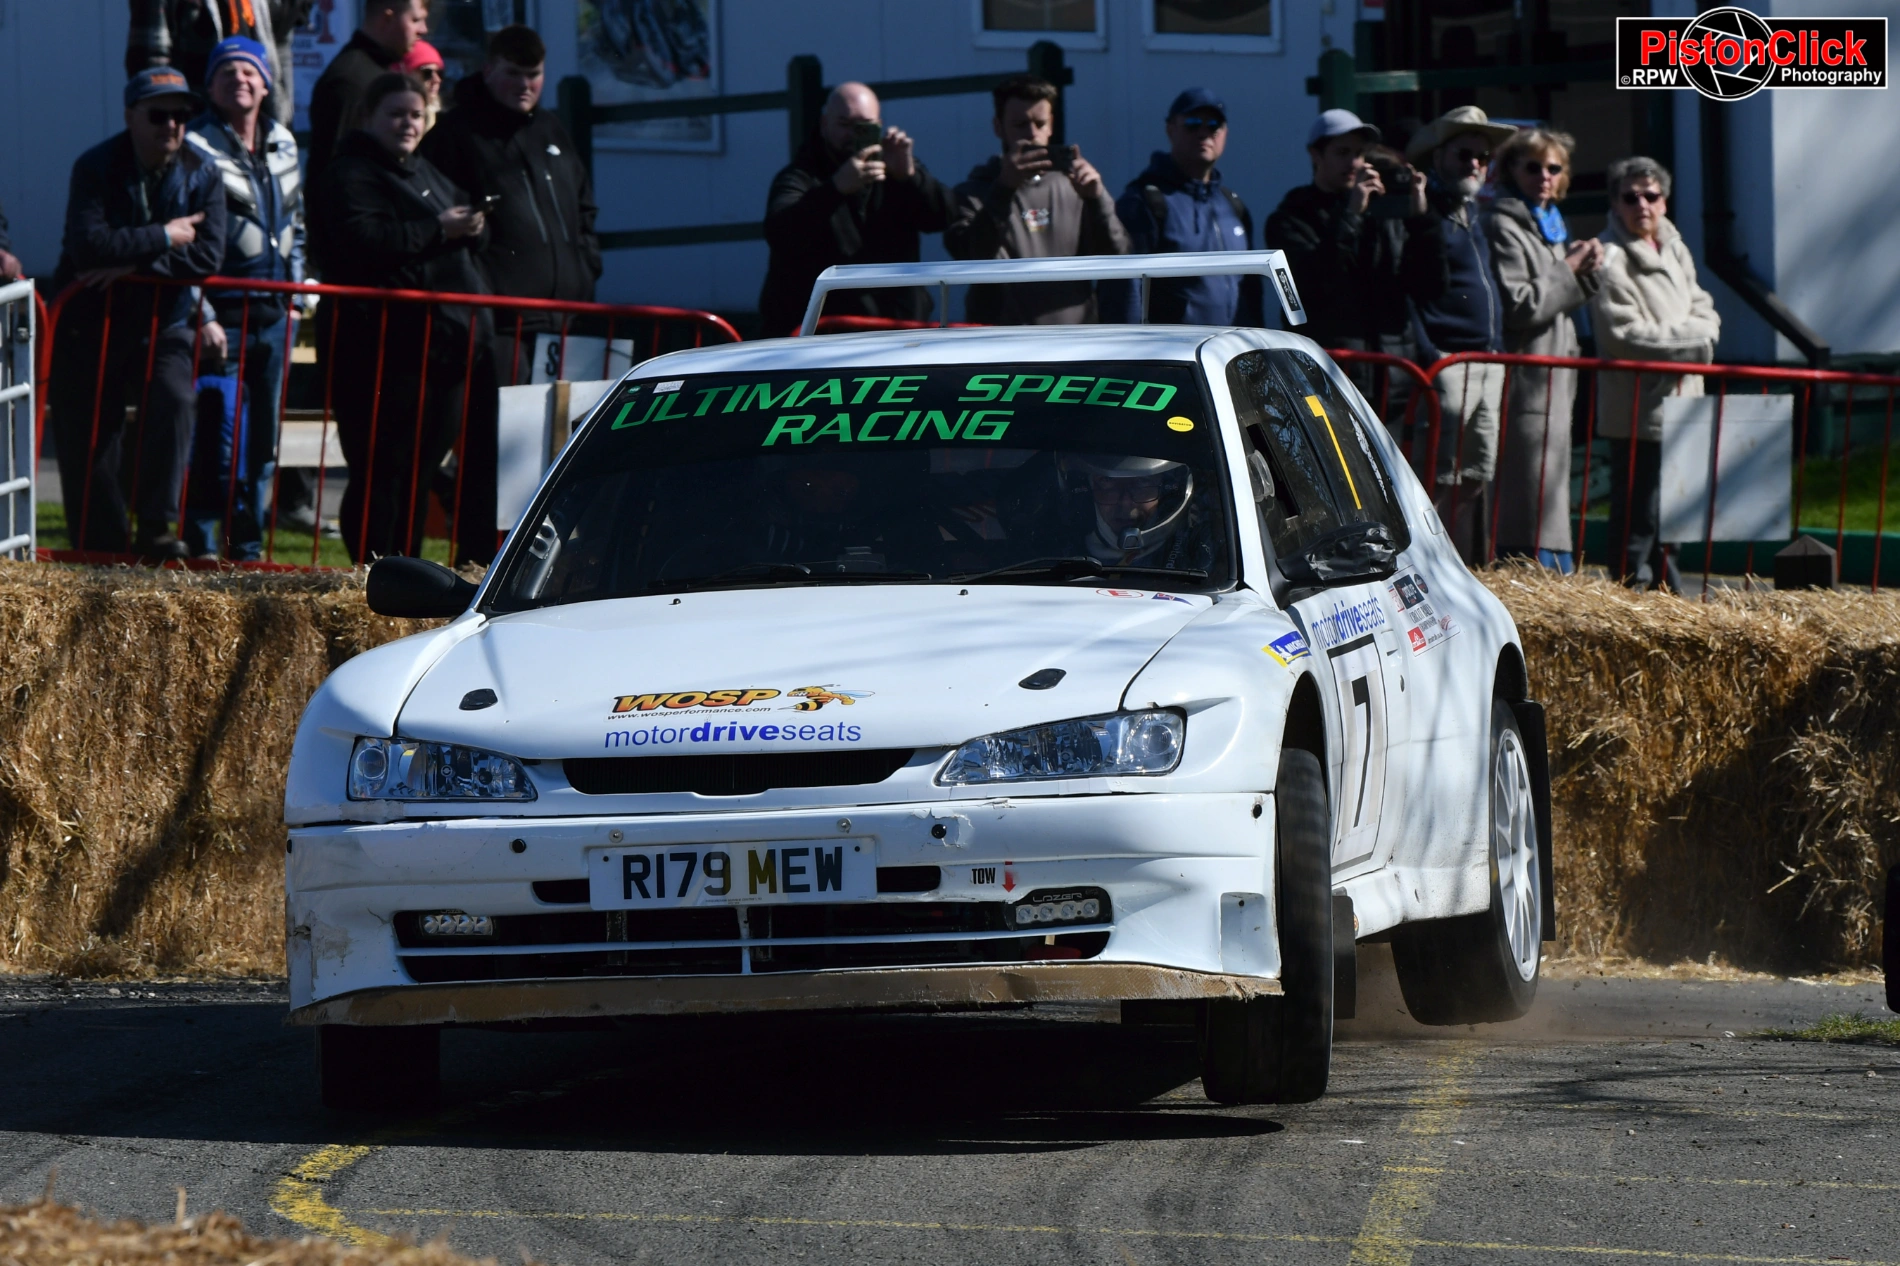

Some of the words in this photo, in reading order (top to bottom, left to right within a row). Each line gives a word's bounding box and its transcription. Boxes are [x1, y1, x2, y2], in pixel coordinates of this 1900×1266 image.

[611, 375, 929, 431] ULTIMATE
[957, 373, 1179, 412] SPEED
[761, 409, 1015, 447] RACING
[1311, 591, 1386, 650] motordriveseats
[606, 706, 772, 720] www.wosperformance.com
[612, 689, 782, 713] WOSP
[604, 721, 862, 748] motordriveseats
[1351, 675, 1371, 828] 7
[622, 851, 731, 900] R179
[747, 846, 843, 895] MEW
[971, 867, 996, 884] TOW
